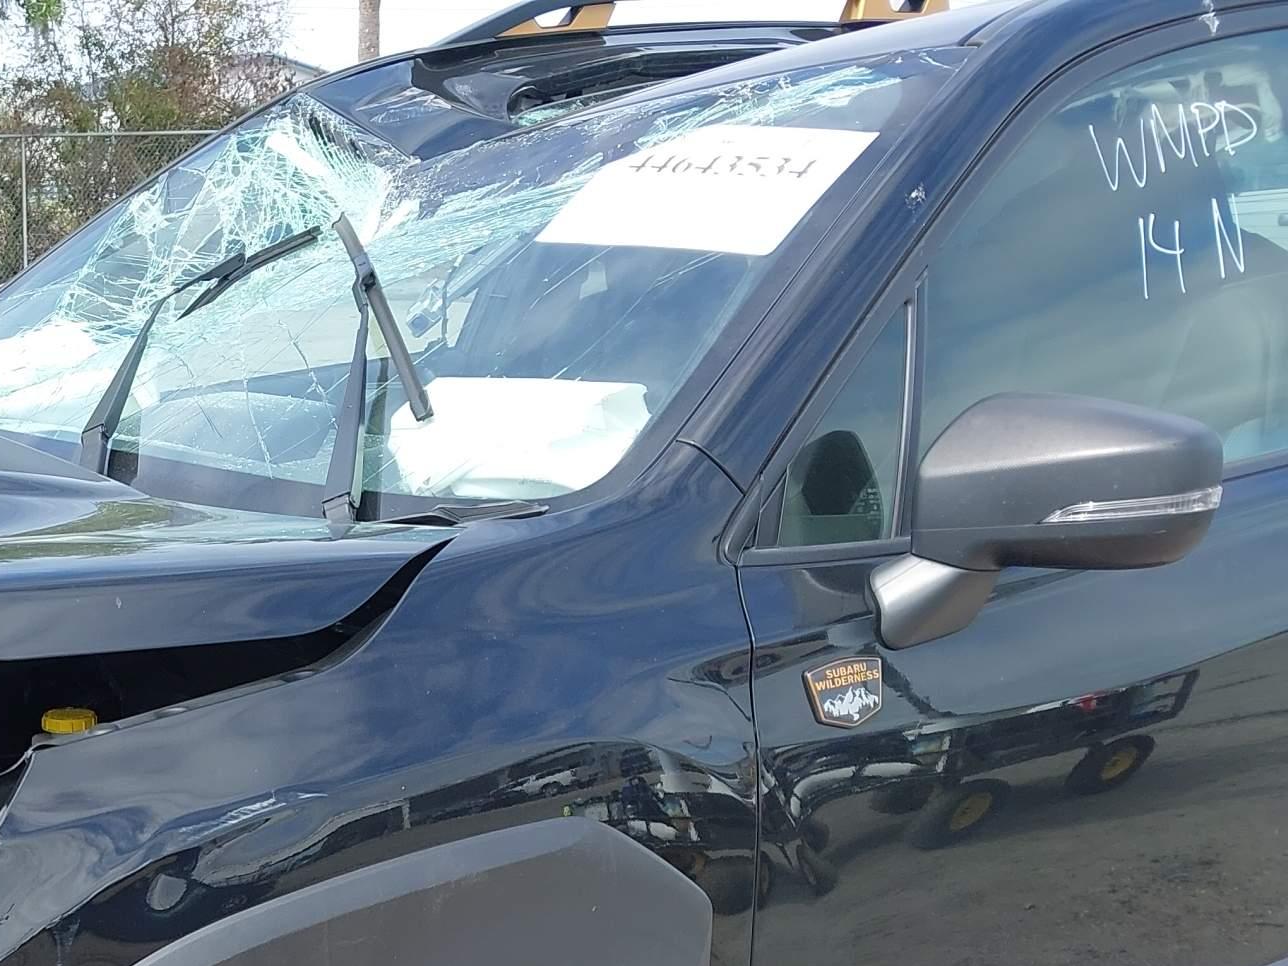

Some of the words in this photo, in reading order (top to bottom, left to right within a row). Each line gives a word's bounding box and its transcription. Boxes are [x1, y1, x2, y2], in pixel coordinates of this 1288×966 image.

[1088, 100, 1258, 191] WMPD
[1138, 213, 1187, 300] 14
[1211, 193, 1245, 279] N
[815, 669, 880, 691] WILDERNESS
[825, 662, 867, 680] SUBARU
